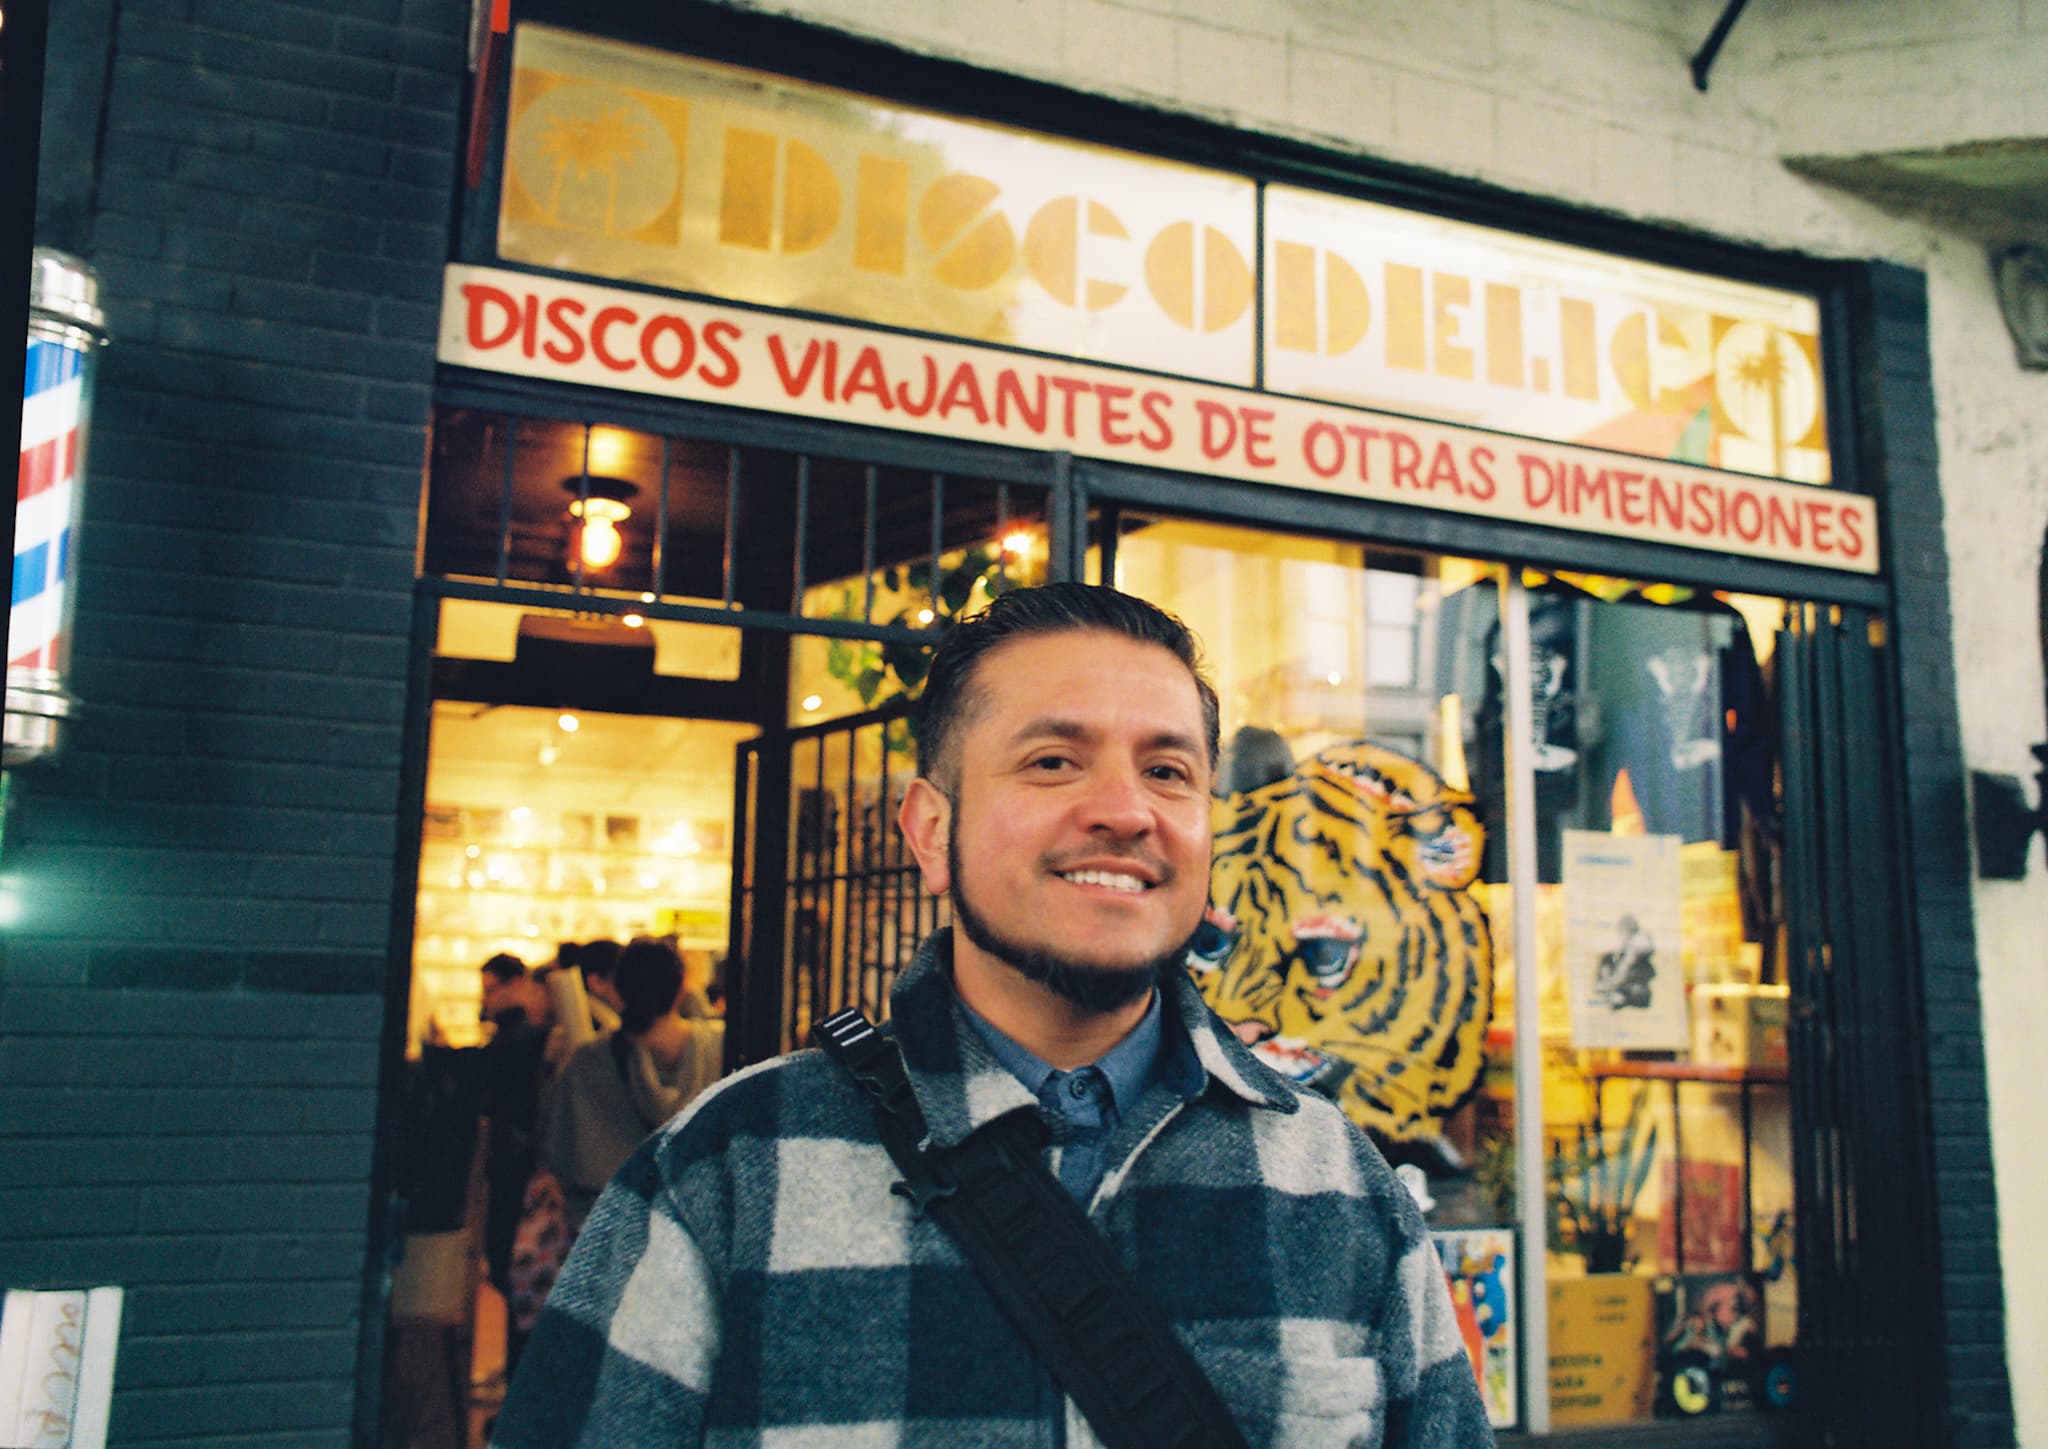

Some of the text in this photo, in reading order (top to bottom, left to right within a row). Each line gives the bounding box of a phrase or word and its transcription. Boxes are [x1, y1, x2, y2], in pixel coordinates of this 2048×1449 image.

[463, 285, 1863, 559] DISCOS VIAJANTES DE OTRAS DIMENSIONES
